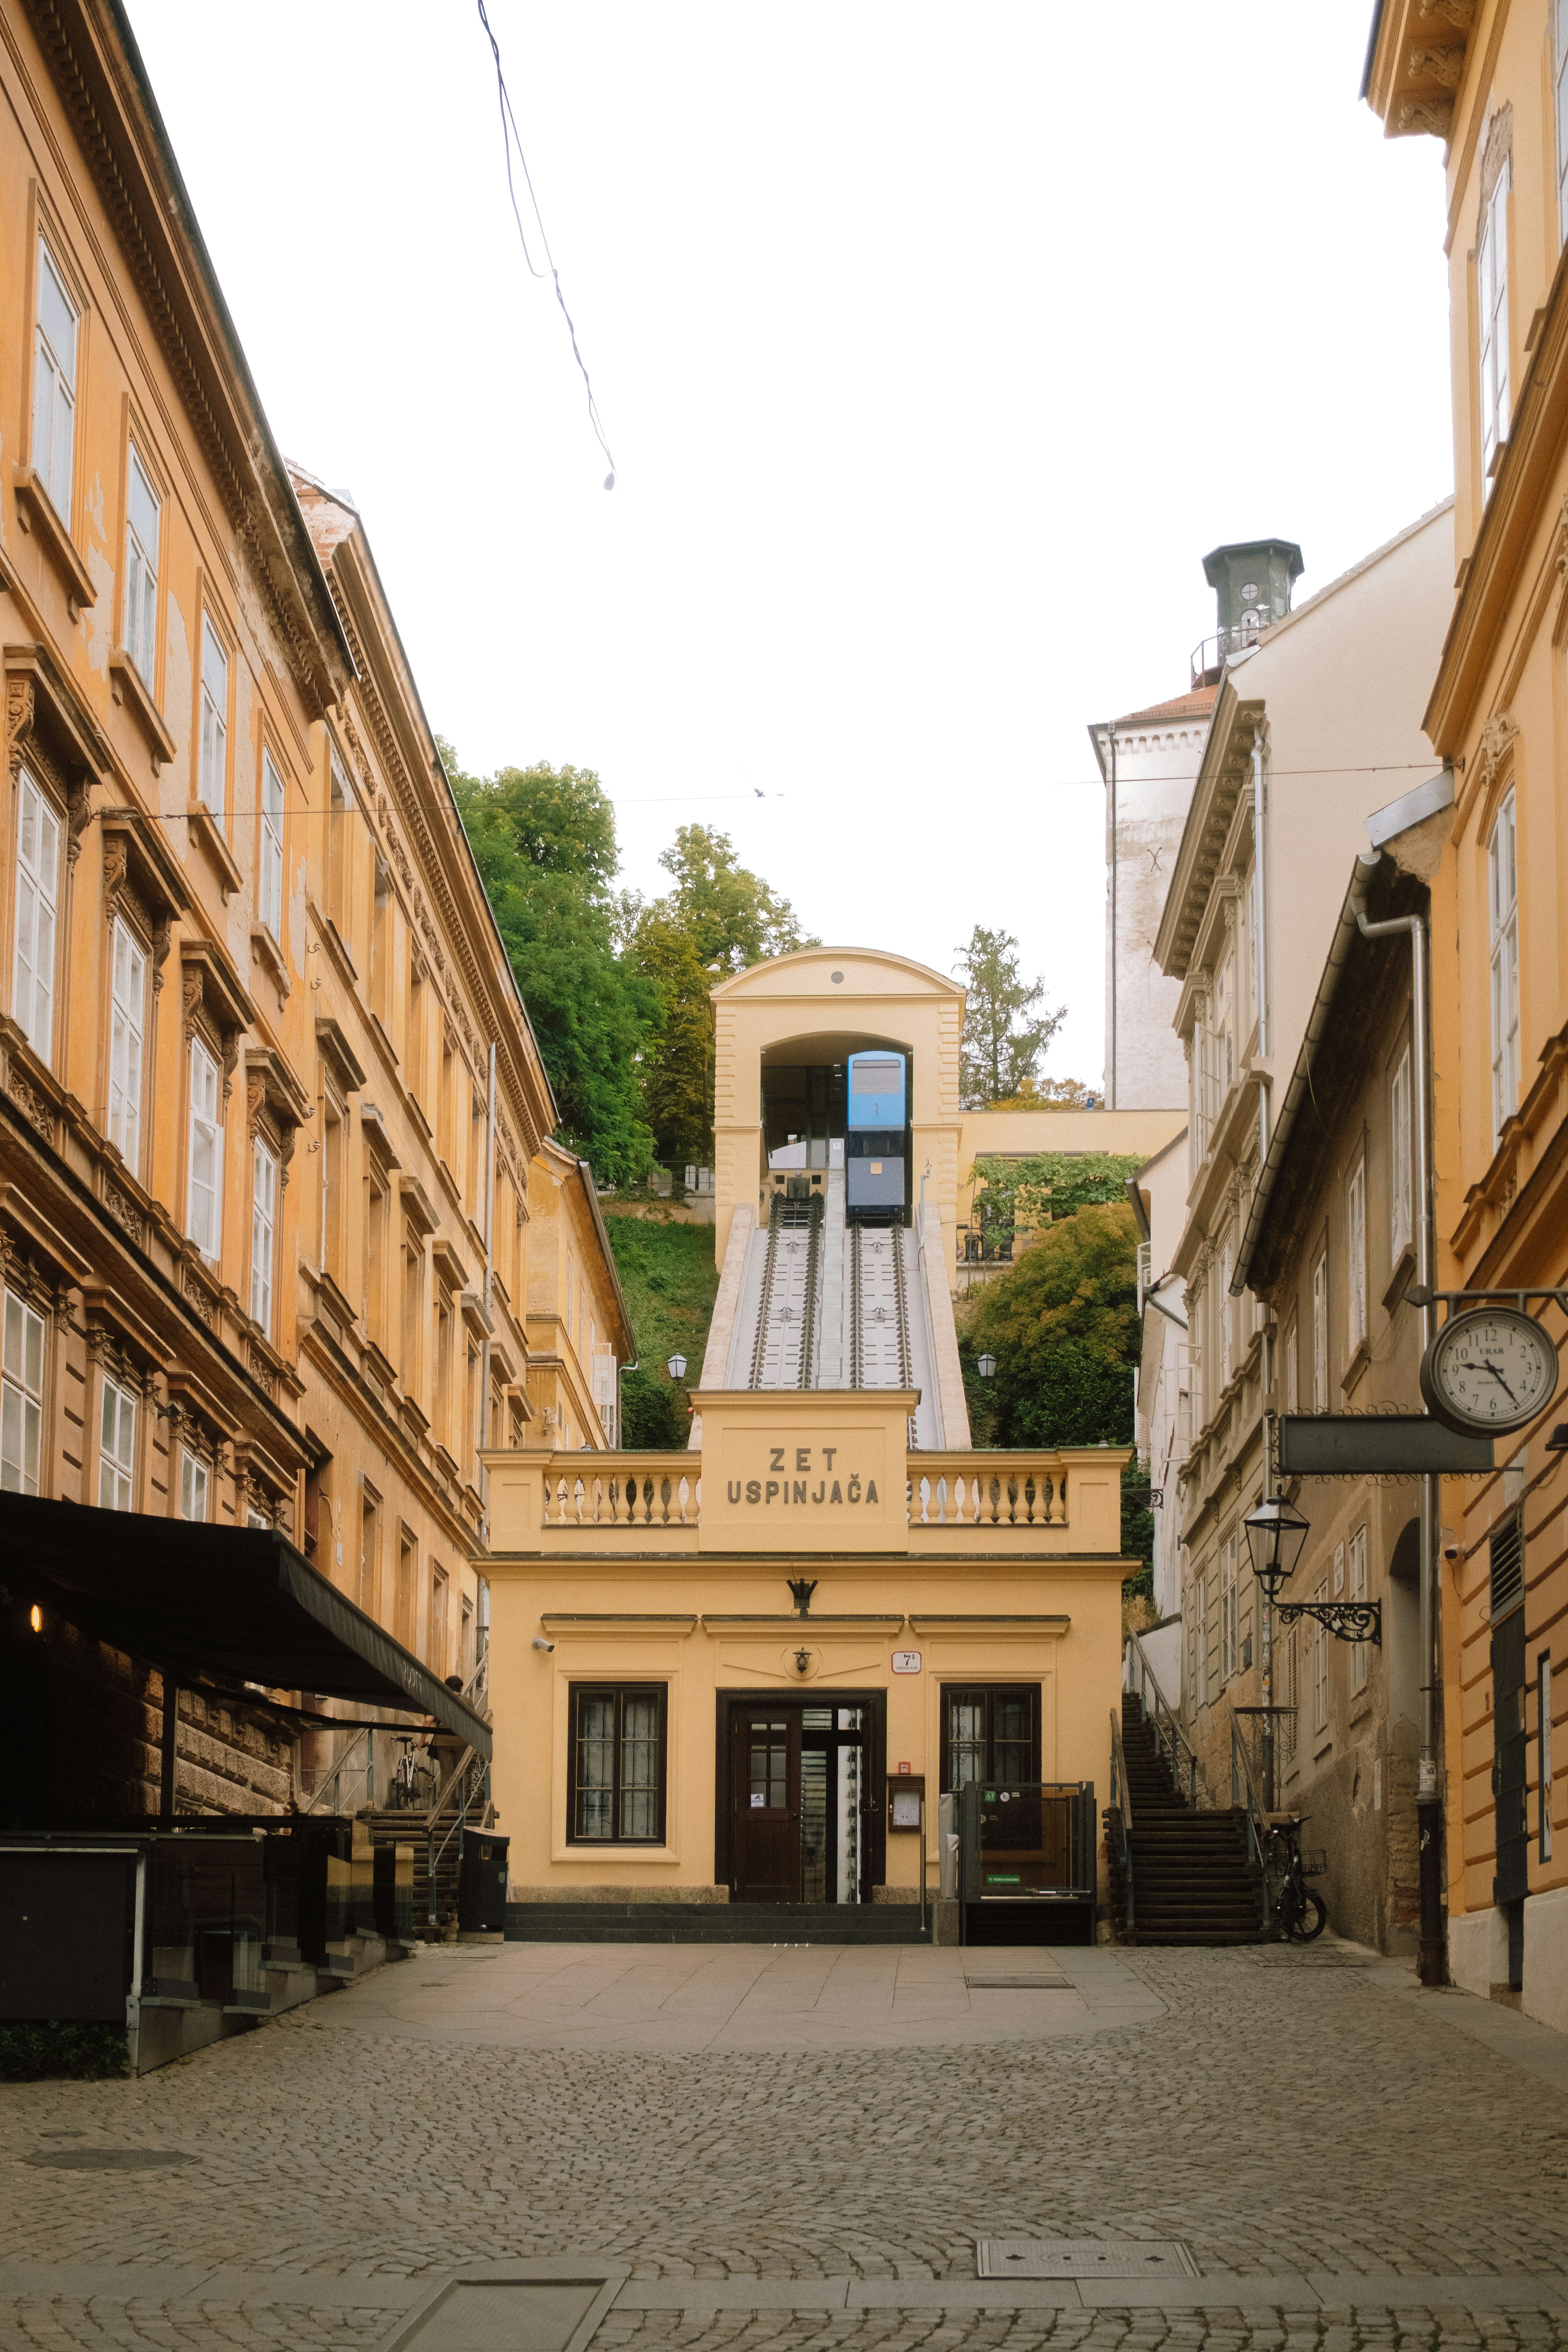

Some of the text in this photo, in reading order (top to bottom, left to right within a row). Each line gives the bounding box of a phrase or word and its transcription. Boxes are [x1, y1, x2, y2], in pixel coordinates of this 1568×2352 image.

[874, 1103, 878, 1115] 1
[1469, 1334, 1478, 1346] 11
[1485, 1329, 1497, 1341] 12
[1509, 1333, 1513, 1345] 1
[1455, 1348, 1467, 1360] 10
[1520, 1345, 1526, 1357] 2
[1452, 1364, 1459, 1376] 9
[1526, 1362, 1532, 1374] 3
[1459, 1381, 1465, 1394] 8
[1520, 1380, 1527, 1391] 4
[1472, 1394, 1479, 1406] 7
[1490, 1397, 1496, 1409] 6
[770, 1448, 837, 1470] ZET
[728, 1473, 879, 1503] USPINJAČA
